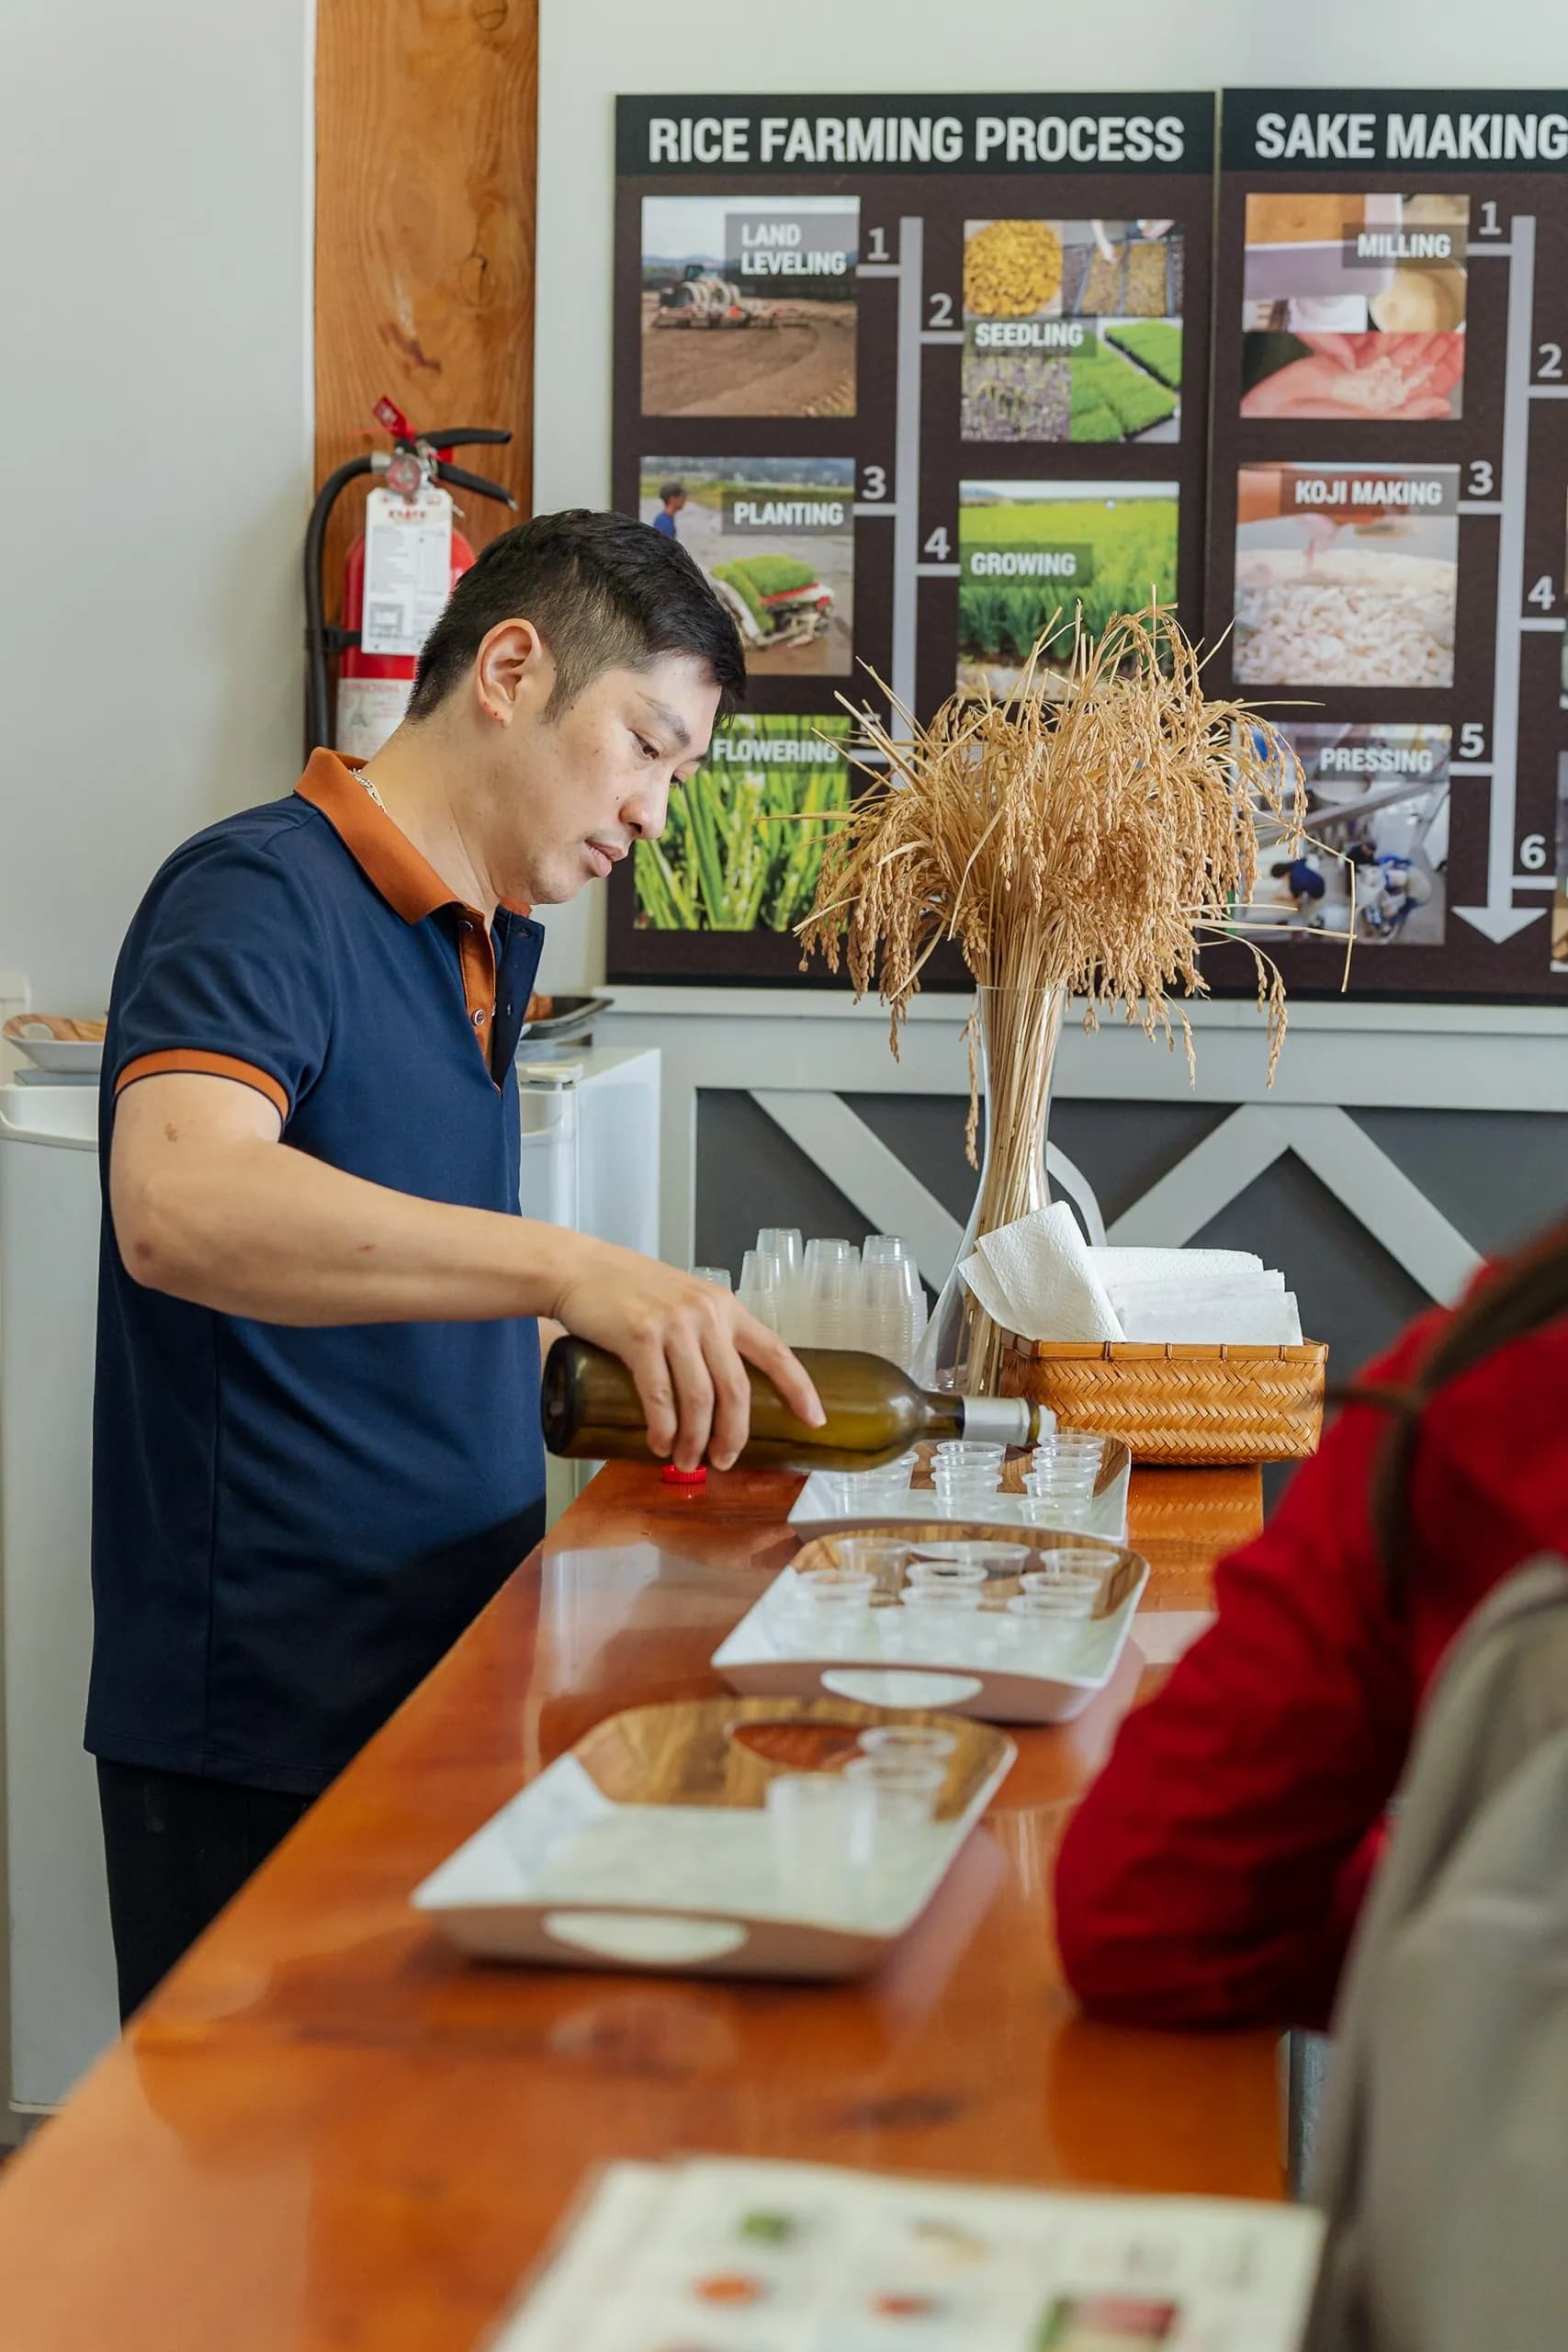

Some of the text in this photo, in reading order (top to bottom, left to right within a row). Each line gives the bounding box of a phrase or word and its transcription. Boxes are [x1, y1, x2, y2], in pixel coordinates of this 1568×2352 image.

[649, 116, 1185, 164] RICE FARMING PROCESS
[1255, 112, 1568, 160] SAKE MAKING
[1478, 200, 1503, 235] 1
[740, 223, 802, 248] LAND
[867, 228, 890, 262] 1
[1357, 233, 1452, 259] MILLING
[740, 251, 847, 277] LEVELING
[928, 292, 954, 327] 2
[974, 322, 1084, 348] SEEDLING
[1537, 343, 1562, 378] 2
[862, 466, 886, 501] 3
[1294, 480, 1443, 505] KOJI MAKING
[1468, 460, 1495, 495] 3
[734, 502, 844, 527] PLANTING
[923, 526, 951, 560] 4
[970, 551, 1077, 577] GROWING
[1527, 575, 1556, 610] 4
[712, 738, 840, 763] FLOWERING
[1458, 723, 1485, 758] 5
[1320, 747, 1434, 774] PRESSING
[1519, 834, 1547, 870] 6
